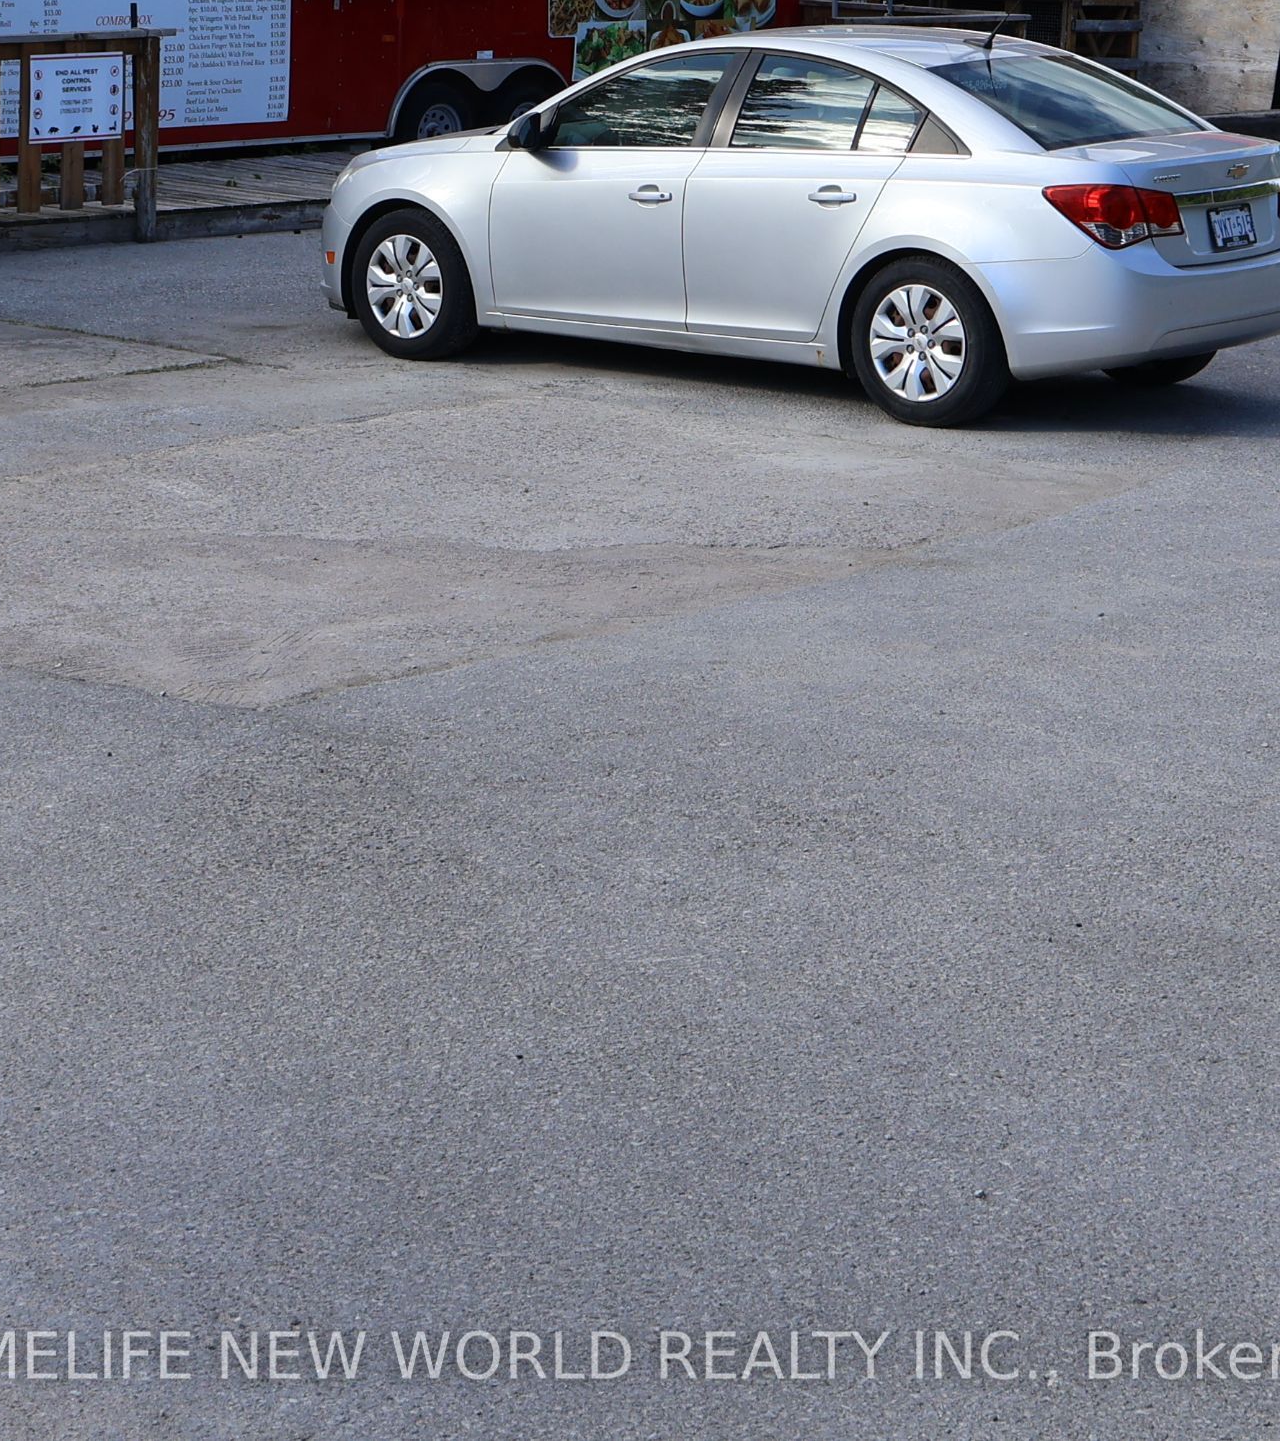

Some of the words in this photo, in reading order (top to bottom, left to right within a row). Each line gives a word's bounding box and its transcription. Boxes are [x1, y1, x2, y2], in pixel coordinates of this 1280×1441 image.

[164, 44, 185, 52] $23.00
[163, 55, 184, 64] $23.00
[163, 68, 183, 76] $23.00
[161, 79, 182, 88] $23.00
[62, 85, 91, 93] SERVICES
